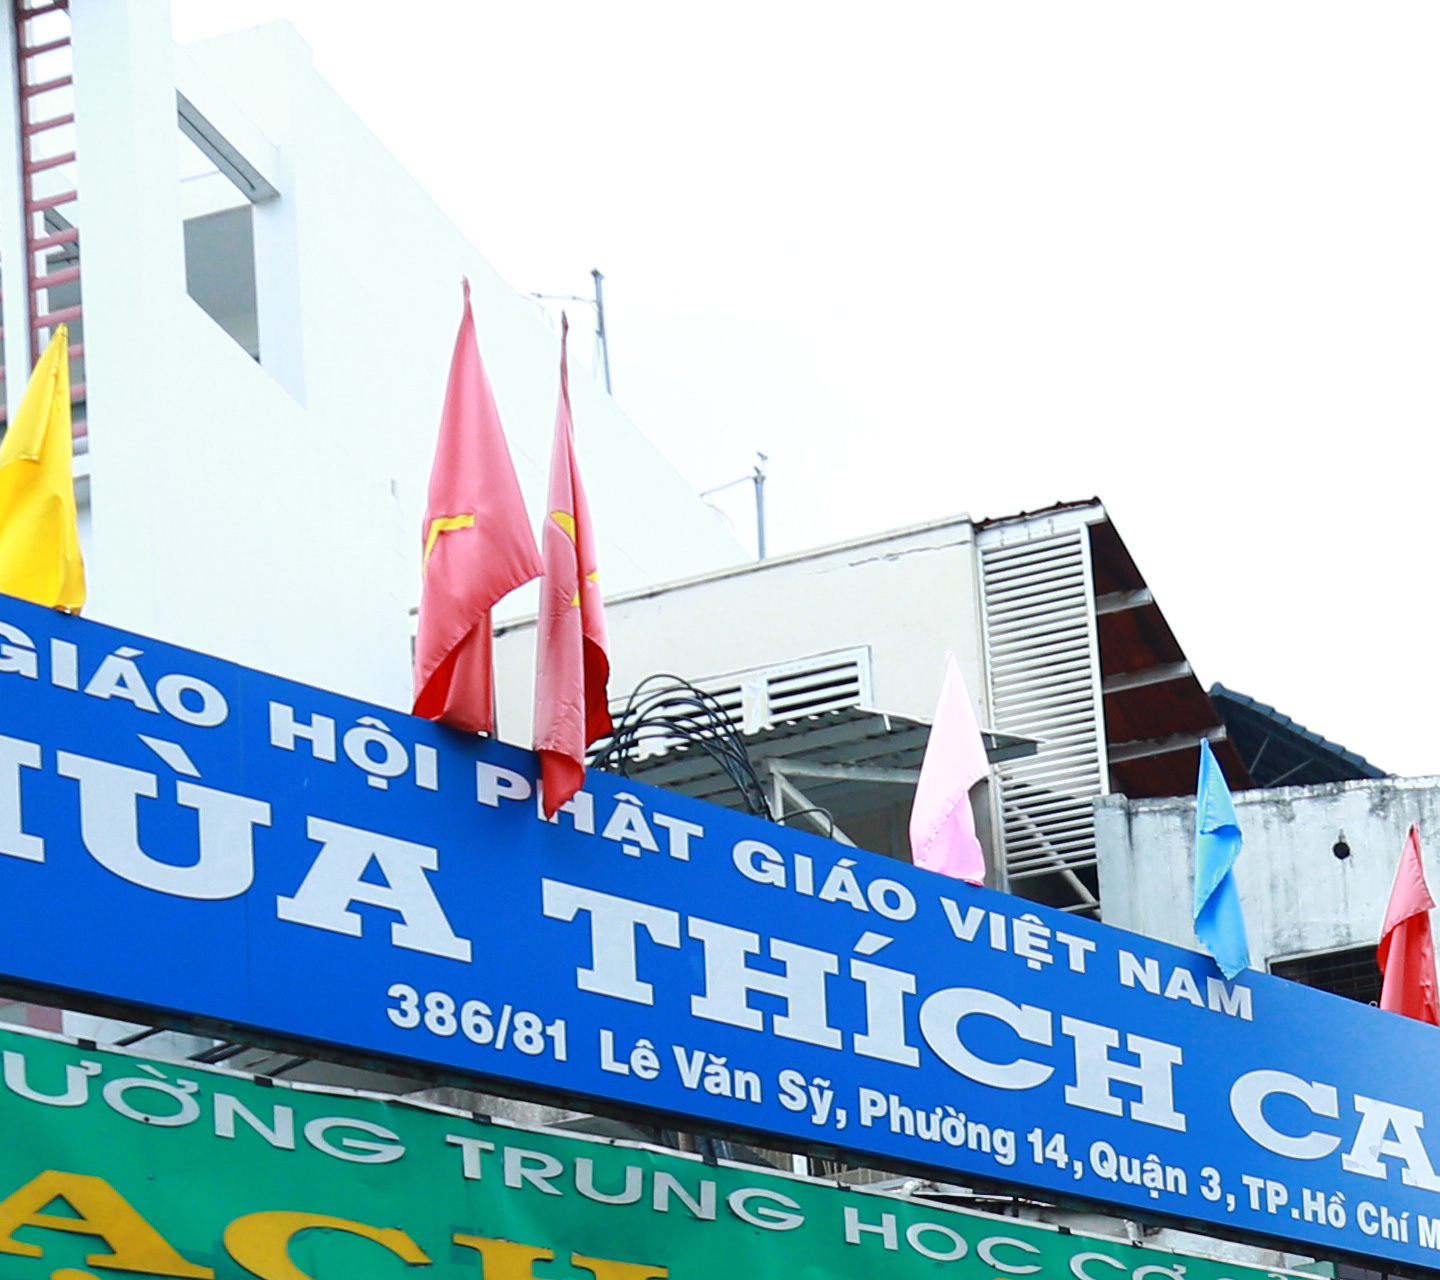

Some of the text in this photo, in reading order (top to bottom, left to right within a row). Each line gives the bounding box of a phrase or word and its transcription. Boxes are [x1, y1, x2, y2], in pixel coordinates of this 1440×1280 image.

[268, 703, 439, 791] HỘI
[475, 763, 704, 863] PHẬT
[733, 834, 918, 923] GIÁO
[939, 895, 1097, 974] VIỆT
[1118, 955, 1253, 1021] NAM
[387, 983, 567, 1064] 386/81
[599, 1028, 660, 1082] Lê
[671, 1048, 762, 1104] Văn
[778, 1064, 847, 1131] Sỹ,
[859, 1087, 1017, 1168] Phường
[1198, 1166, 1237, 1214] 3,
[1354, 1203, 1410, 1244] Chí
[542, 879, 1187, 1131] THÍCH
[445, 1131, 804, 1231] TRUNG
